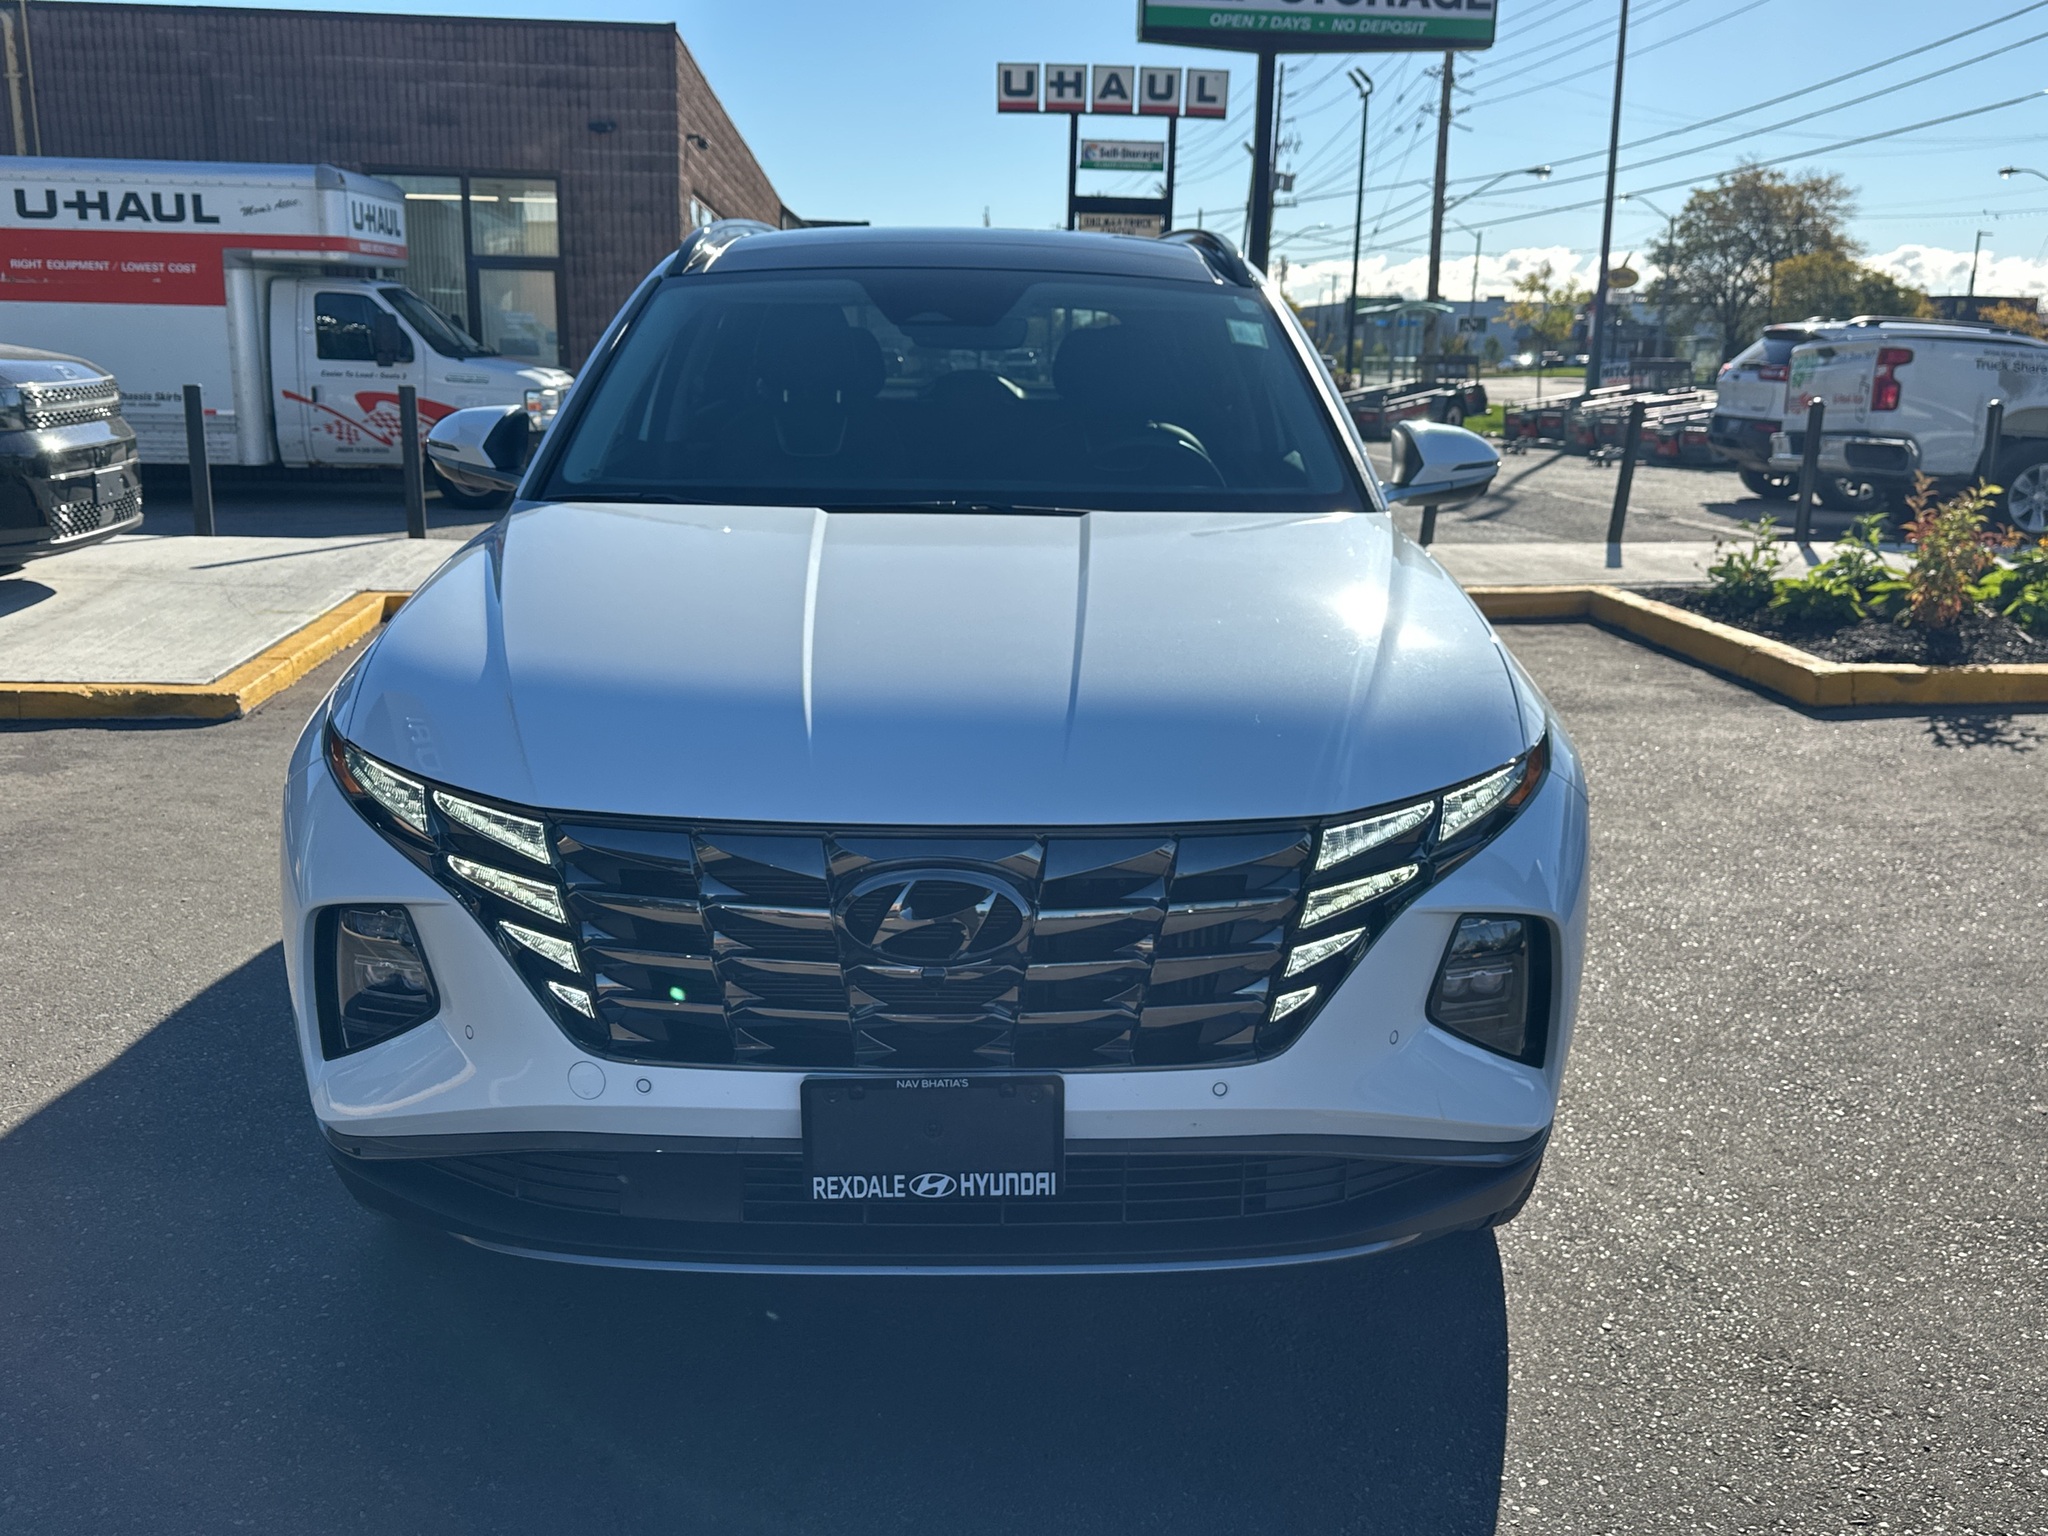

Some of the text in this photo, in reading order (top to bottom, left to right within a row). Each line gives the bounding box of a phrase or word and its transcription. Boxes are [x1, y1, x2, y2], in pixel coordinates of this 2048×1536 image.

[1209, 13, 1428, 35] OPEN 7 DAYS NO DEPOSIT
[1100, 147, 1160, 161] Self-Storage
[10, 258, 42, 270] RIGHT
[46, 260, 110, 271] EQUIPMENT
[120, 262, 165, 273] LOWEST
[168, 263, 197, 274] COST
[1976, 357, 2048, 376] Truck Share
[896, 1078, 969, 1089] NAV BHATIA'S
[812, 1172, 1056, 1200] REXDALE HYUNDAI
